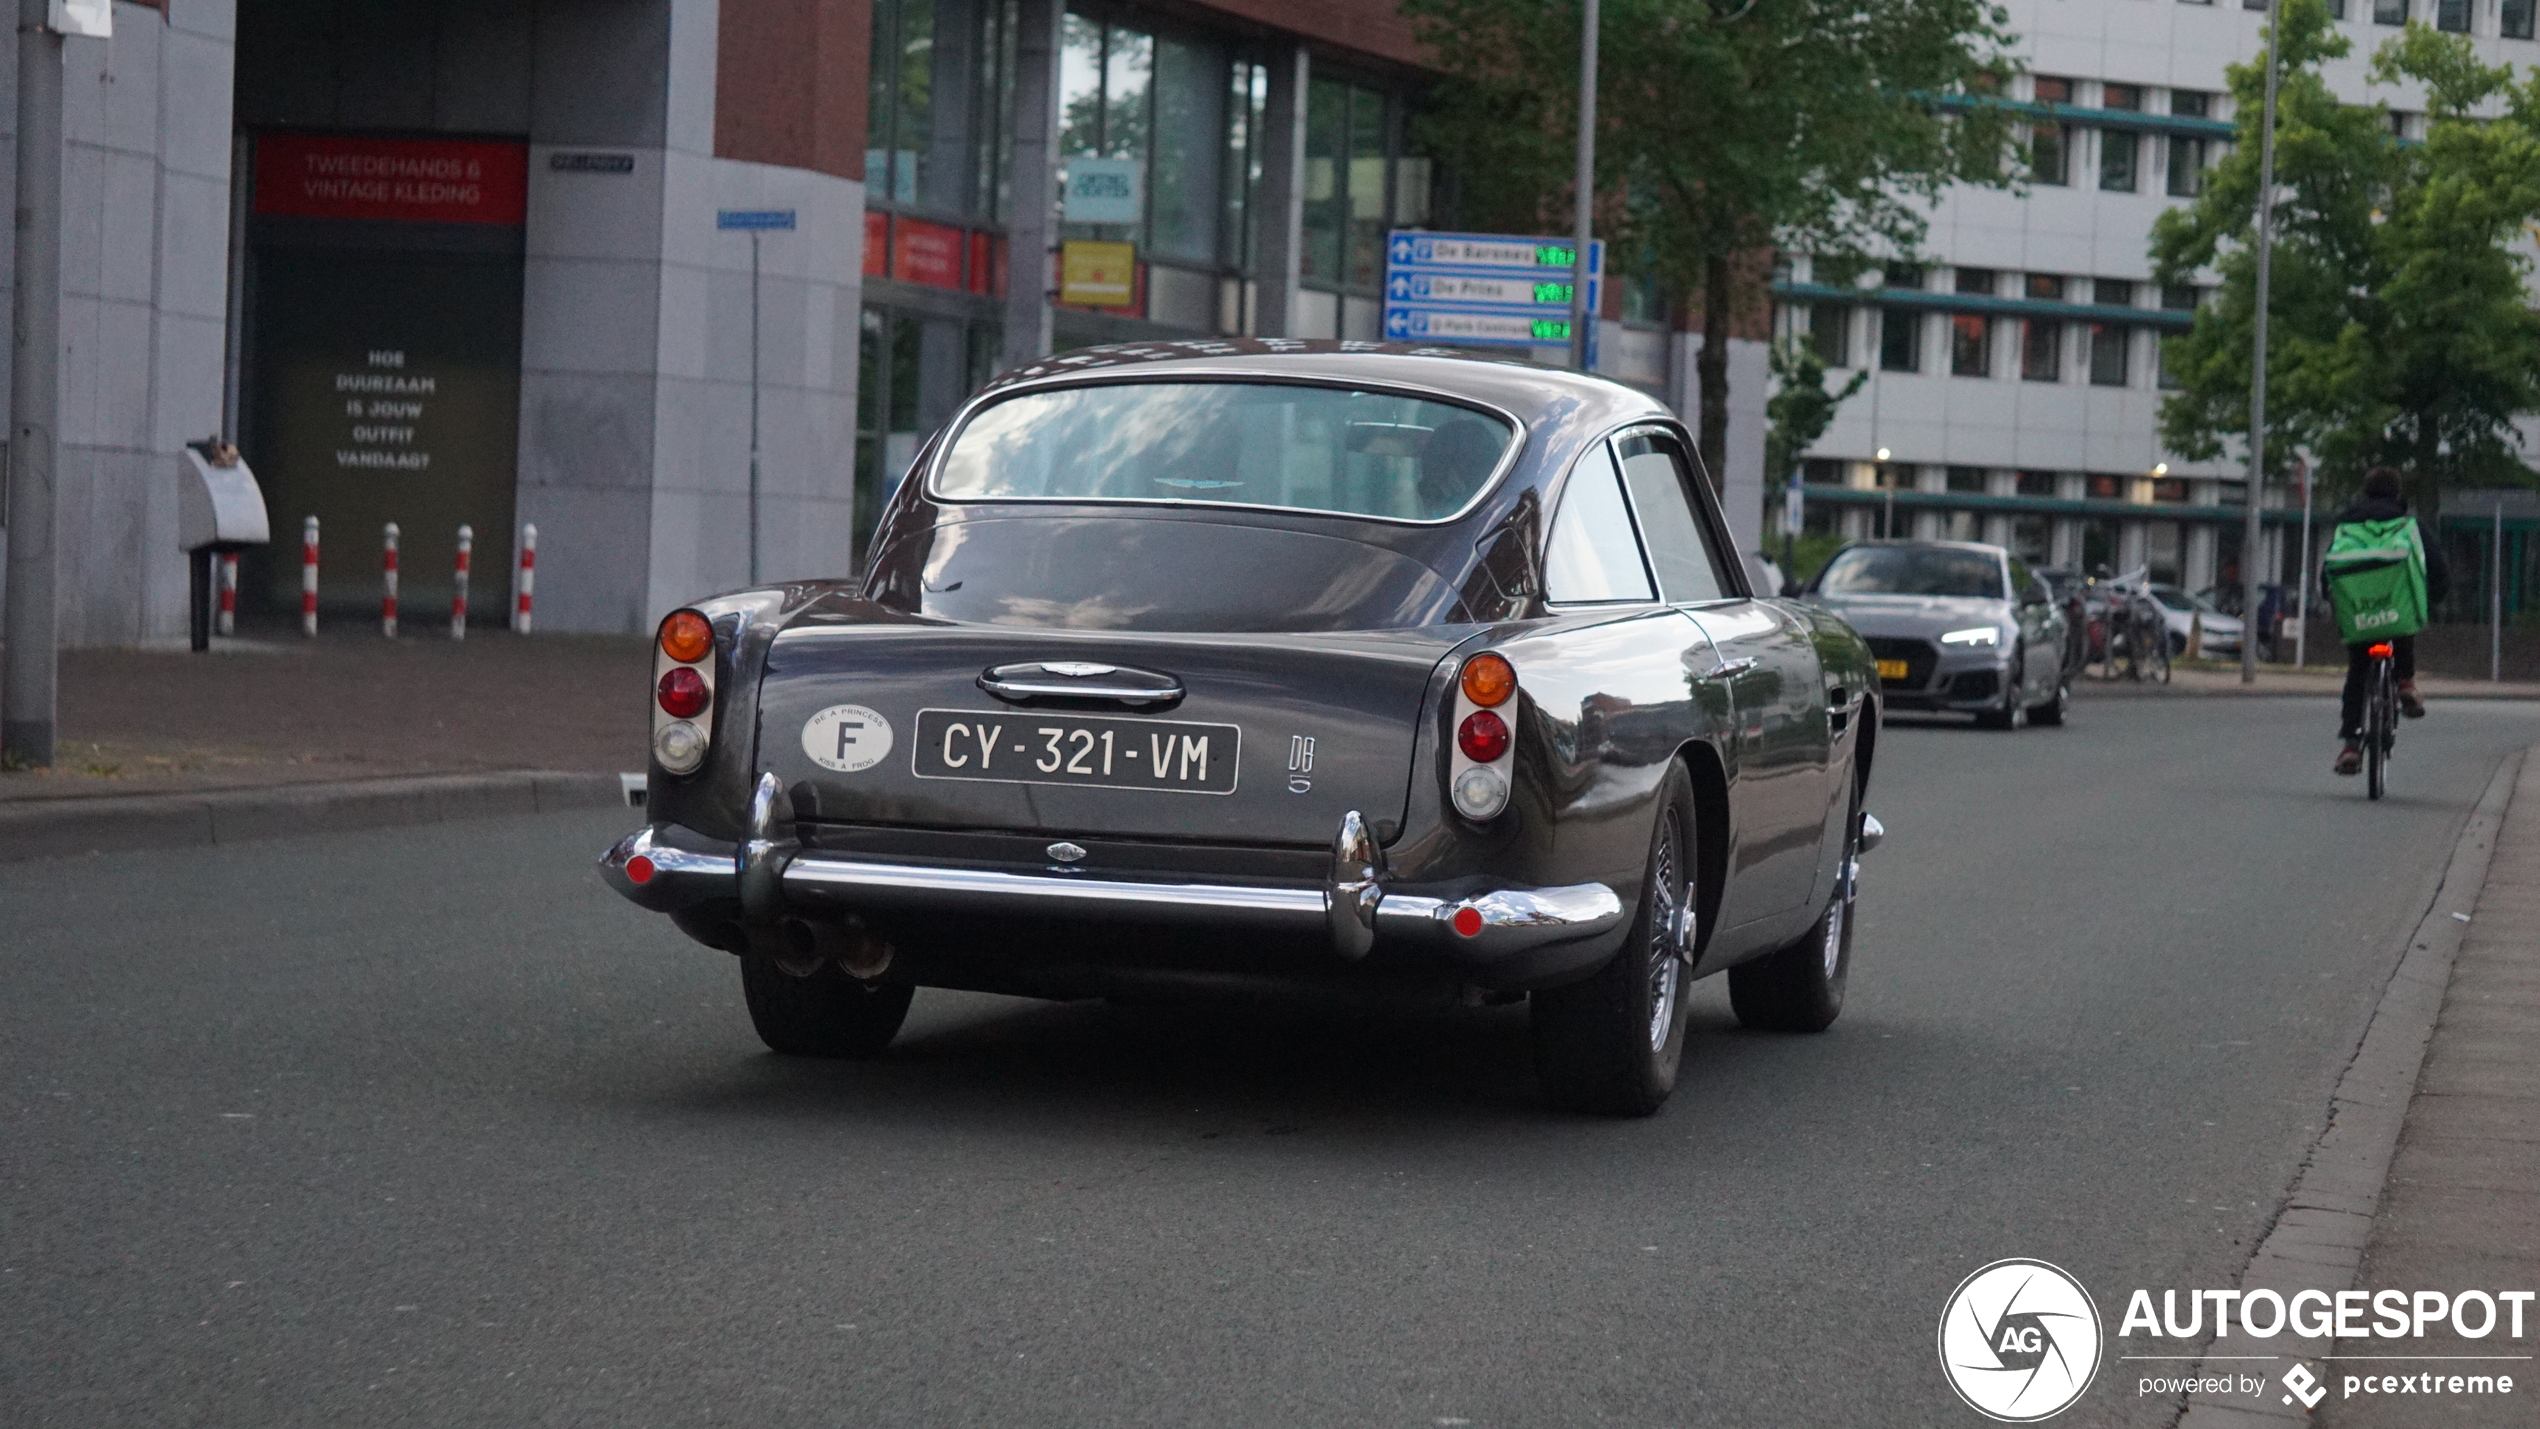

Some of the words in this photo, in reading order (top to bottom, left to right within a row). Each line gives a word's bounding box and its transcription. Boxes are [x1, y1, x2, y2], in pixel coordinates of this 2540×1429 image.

[305, 153, 462, 178] TWEEDEHANDS
[304, 180, 389, 201] VINTAGE
[394, 182, 480, 205] KLEDING
[1437, 241, 1457, 256] De
[1434, 276, 1454, 294] De
[368, 350, 405, 368] HOE
[336, 374, 436, 394] DUURZAAM
[346, 400, 363, 417] IS
[368, 401, 422, 419] JOUW
[352, 426, 414, 443] OUTFIT
[336, 450, 430, 470] VANDAAG?
[2354, 609, 2399, 631] Eats
[814, 714, 826, 725] BE
[841, 708, 884, 728] PRINCESS
[836, 721, 865, 760] F
[818, 756, 836, 768] KISS
[852, 758, 875, 770] FROG
[1288, 735, 1316, 773] DB
[1288, 774, 1312, 794] 5
